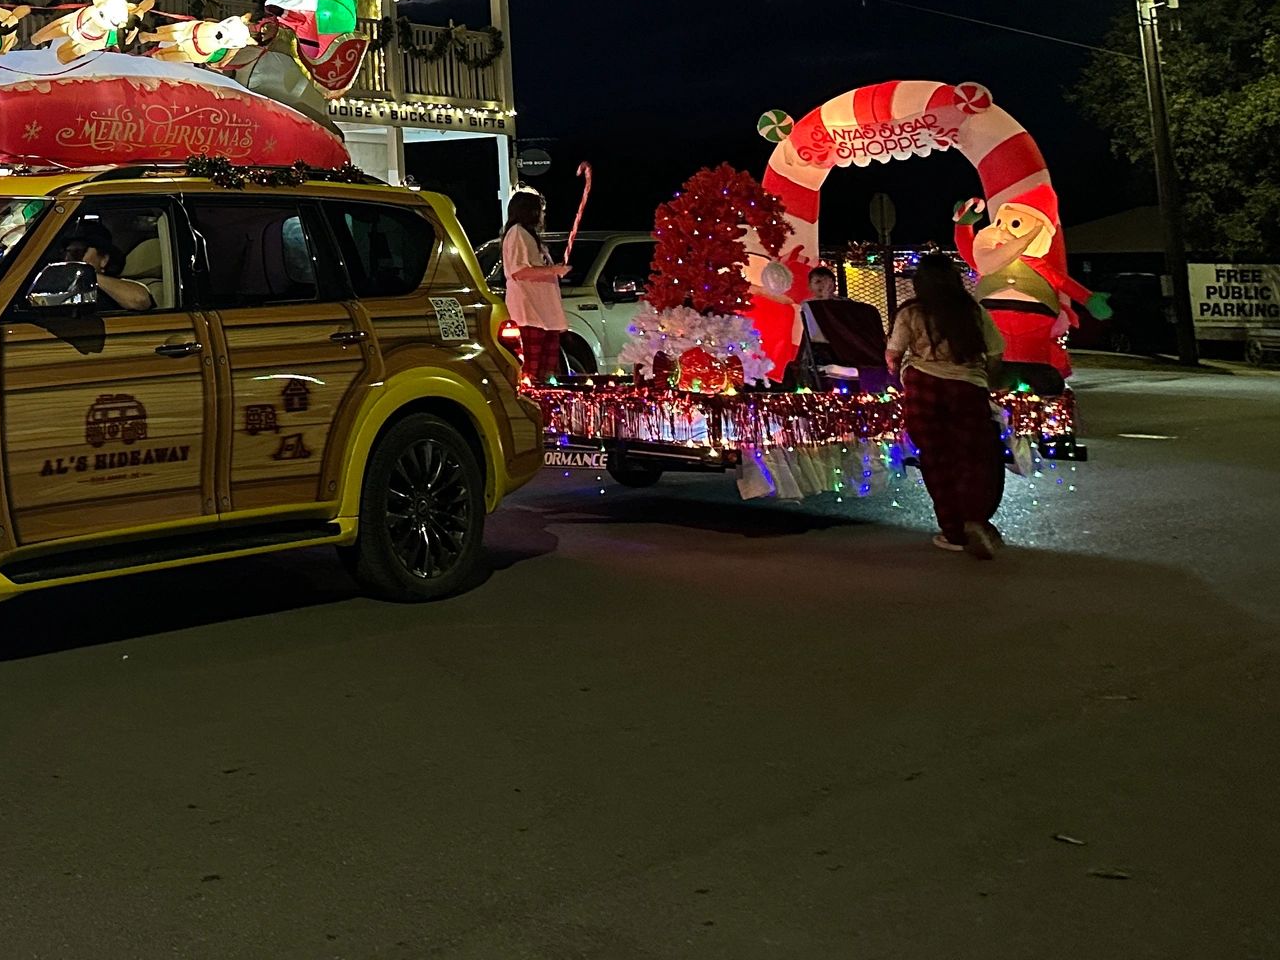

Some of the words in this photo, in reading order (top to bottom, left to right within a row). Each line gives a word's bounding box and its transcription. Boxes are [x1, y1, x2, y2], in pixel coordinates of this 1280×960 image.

[390, 110, 453, 124] BUCKLES
[469, 117, 505, 129] GIFTS
[811, 123, 876, 144] SANTA'S
[879, 114, 939, 139] SUGAR
[78, 119, 152, 145] MERRY
[153, 122, 254, 149] CHRISTMAS
[836, 132, 927, 159] SHOPPE
[1215, 269, 1263, 283] FREE
[1206, 285, 1272, 300] PUBLIC
[1200, 302, 1280, 317] PARKING
[40, 455, 88, 476] AL'S
[94, 445, 191, 470] HIDEAWAY
[544, 451, 609, 467] ORMANCE
